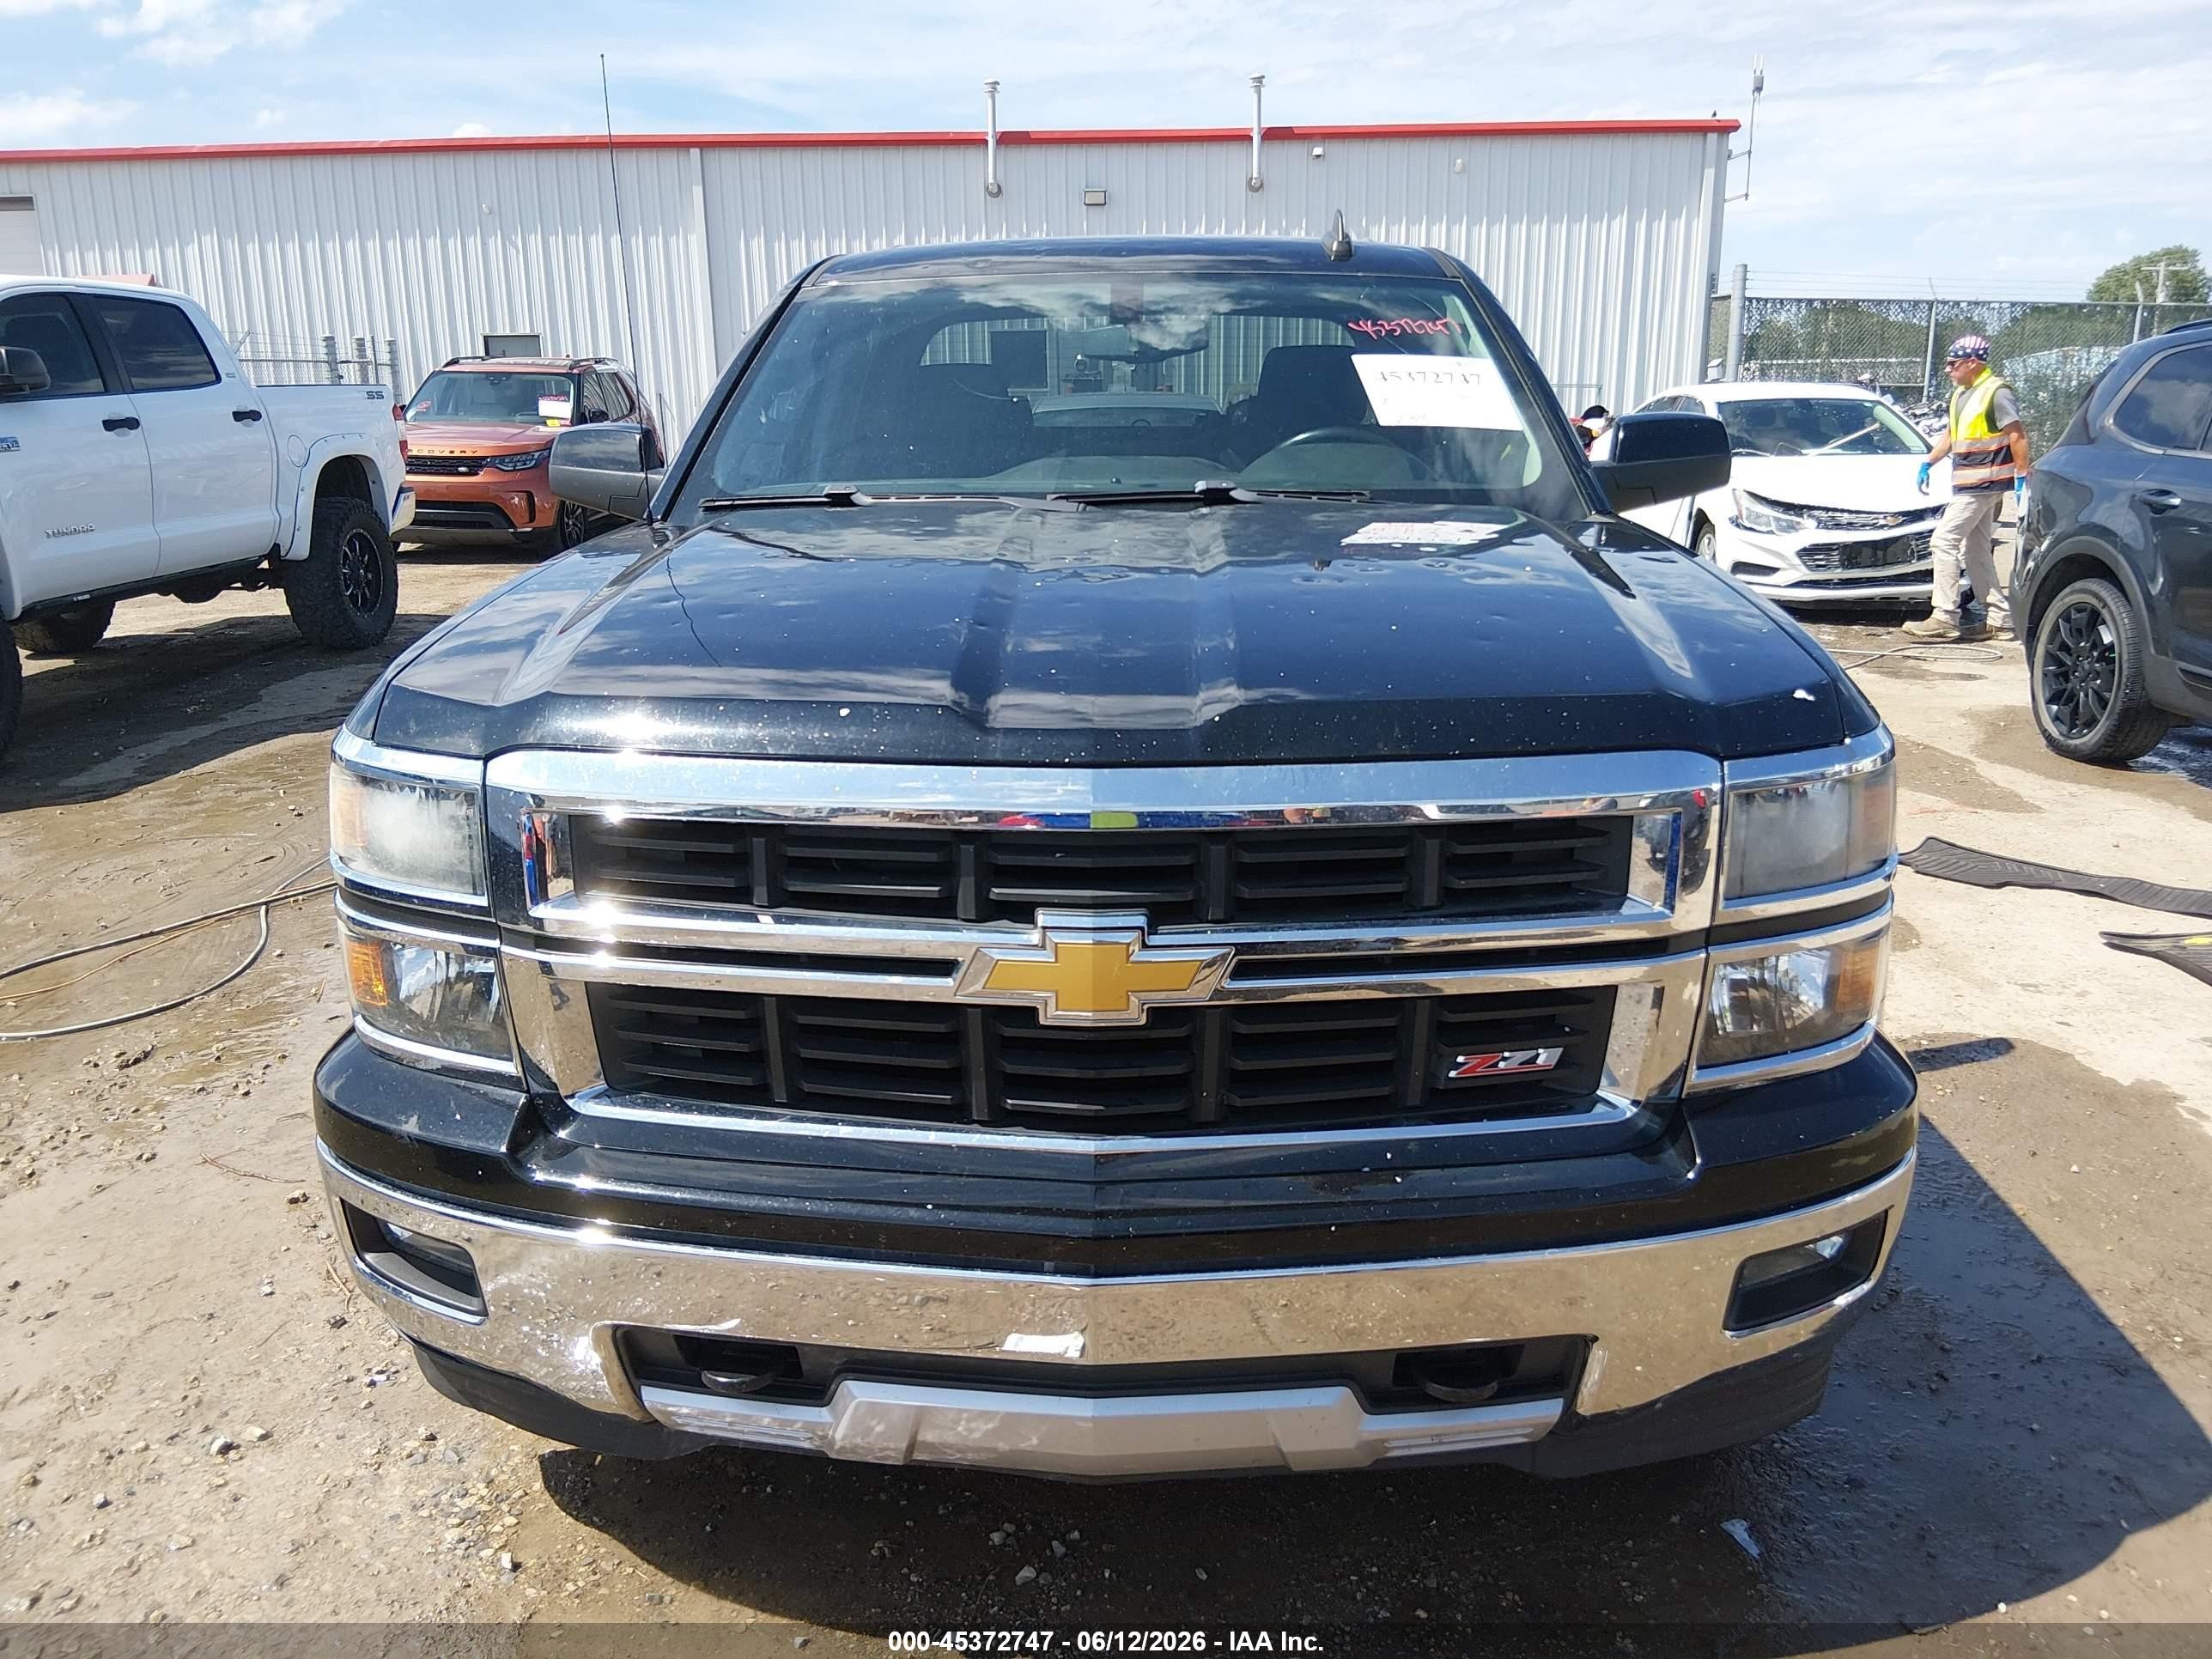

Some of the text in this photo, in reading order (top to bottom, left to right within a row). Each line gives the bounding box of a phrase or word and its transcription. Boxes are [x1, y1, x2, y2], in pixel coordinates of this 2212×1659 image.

[366, 391, 385, 400] SS
[44, 523, 96, 539] TUNDRA
[1448, 1047, 1564, 1078] Z71
